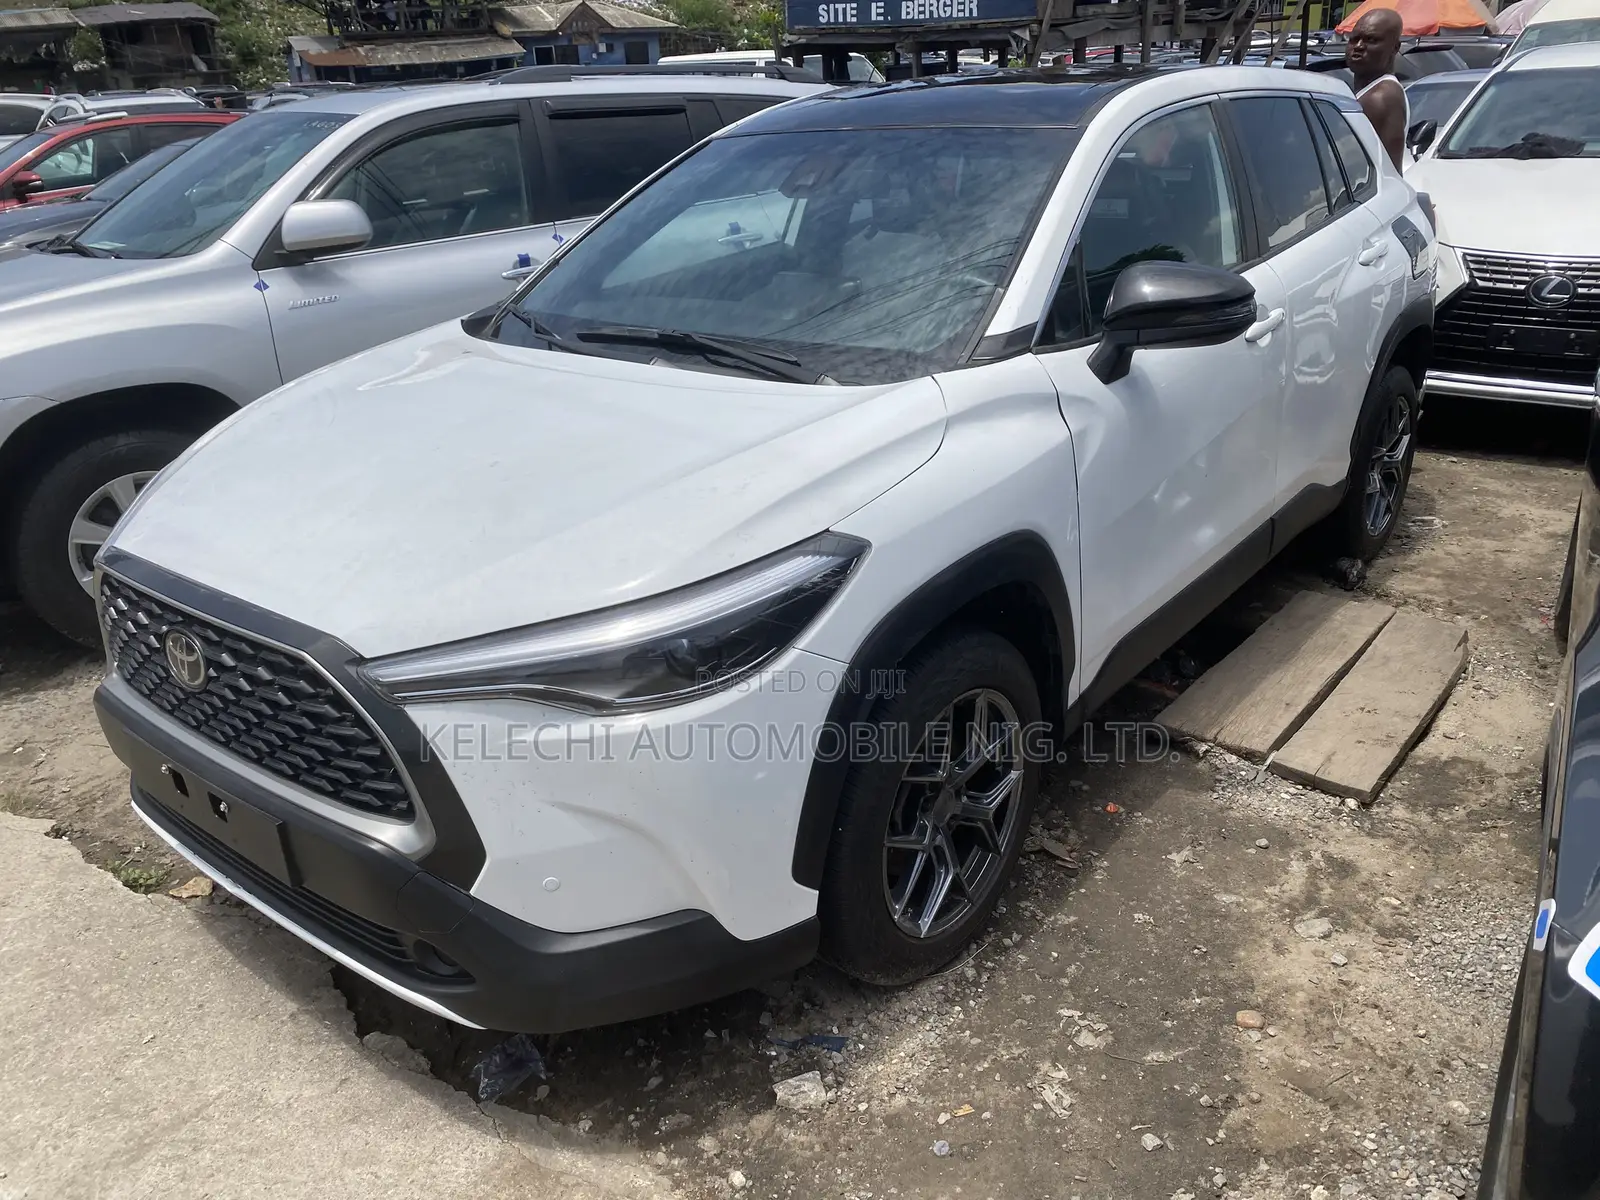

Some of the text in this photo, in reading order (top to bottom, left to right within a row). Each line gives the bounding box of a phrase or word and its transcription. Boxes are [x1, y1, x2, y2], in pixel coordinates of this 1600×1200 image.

[818, 3, 857, 23] SITE
[901, 0, 978, 19] BERGER
[288, 294, 341, 310] LIMITED
